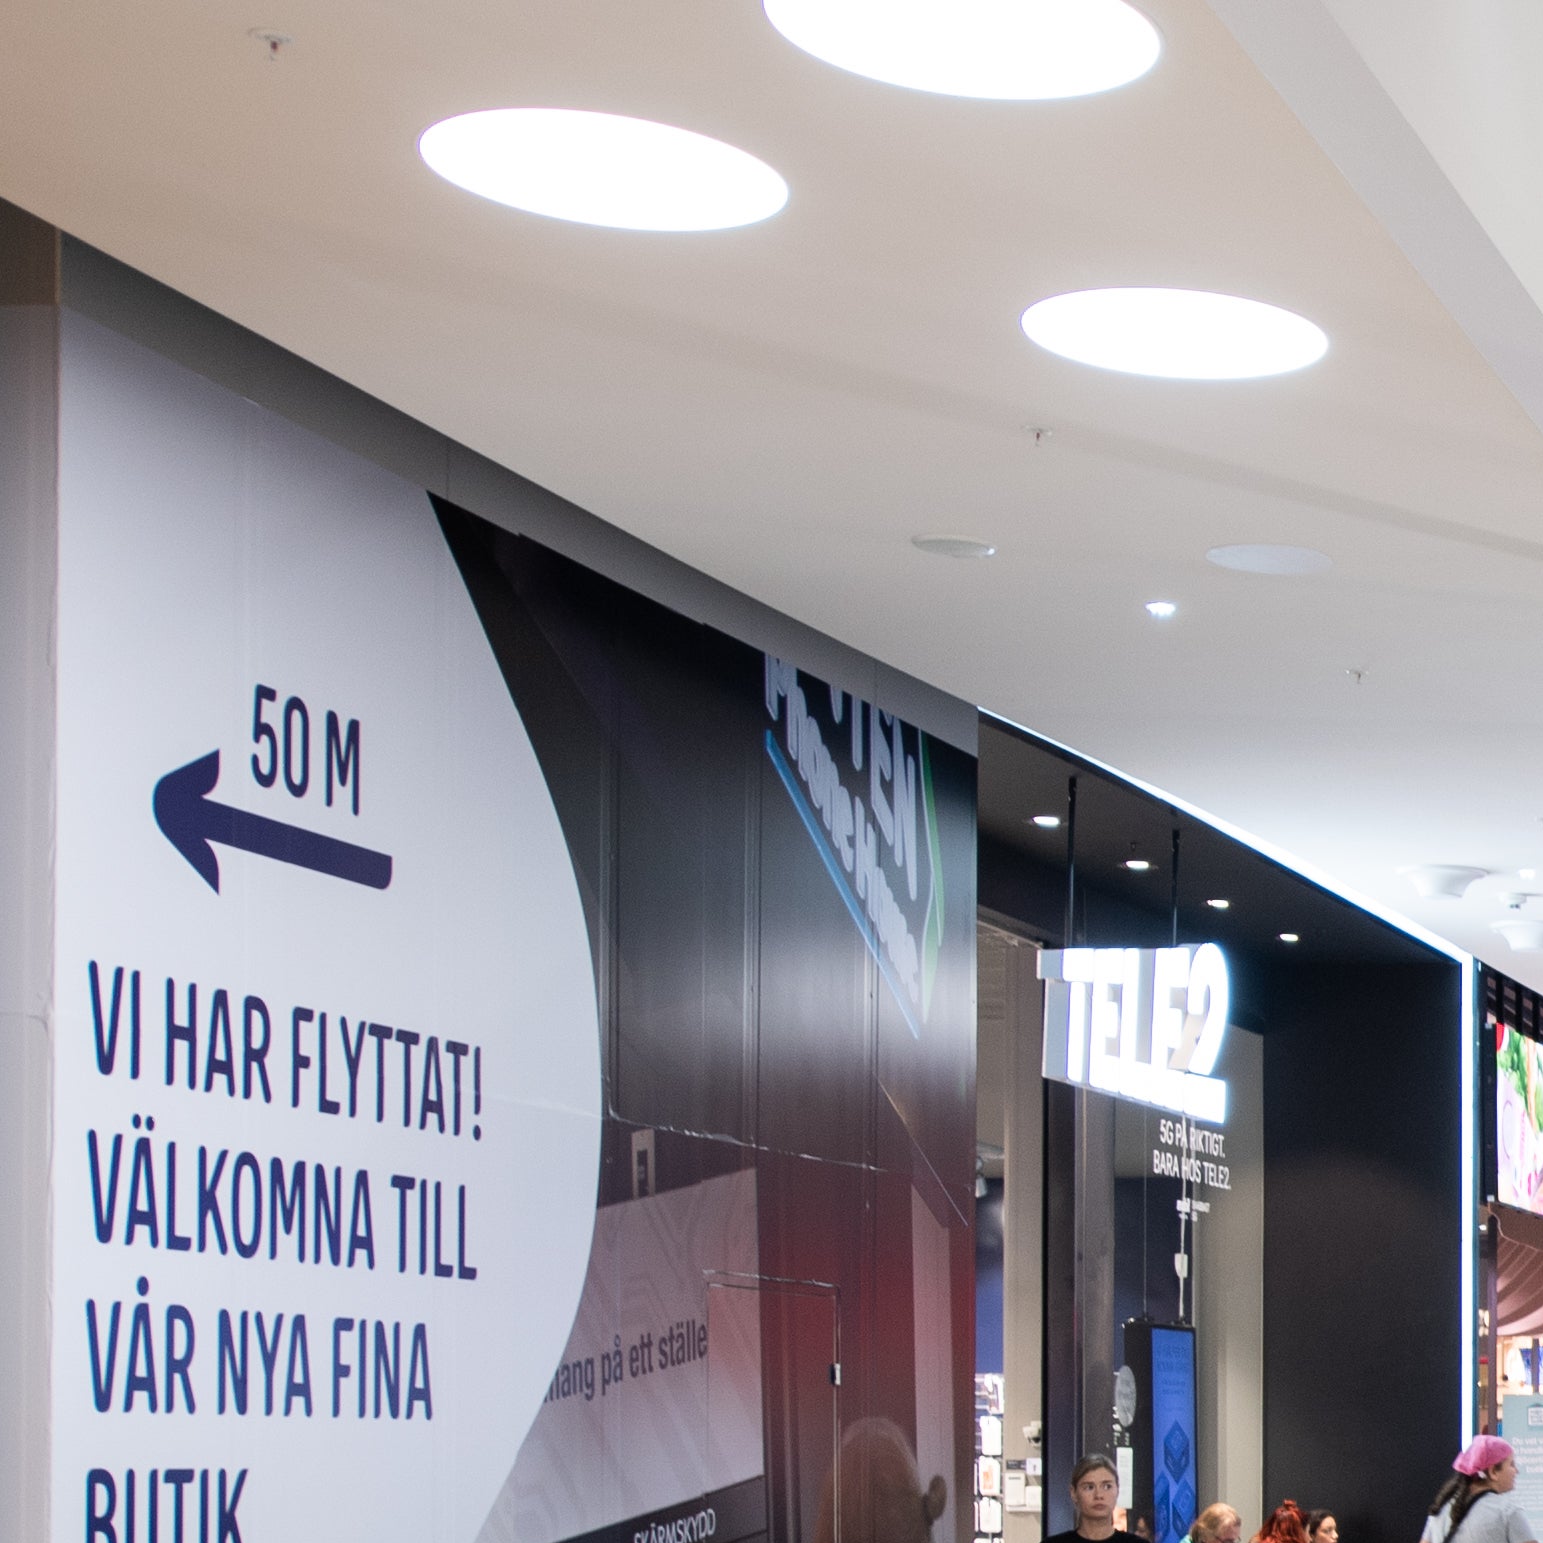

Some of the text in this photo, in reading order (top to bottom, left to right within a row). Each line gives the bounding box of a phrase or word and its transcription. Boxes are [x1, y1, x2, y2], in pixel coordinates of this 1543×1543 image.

[251, 684, 360, 815] 50 M
[88, 960, 482, 1141] VI HAR FLYTTAT!
[1060, 942, 1229, 1124] TELE2
[87, 1114, 477, 1281] VÄLKOMNA TILL
[1152, 1149, 1232, 1190] BARA HOS TELE2.
[1159, 1119, 1173, 1144] 5G
[1190, 1127, 1226, 1158] RIKTIGT.
[86, 1277, 432, 1421] VÅR NYA FINA
[601, 1335, 623, 1396] på
[629, 1332, 653, 1378] ett
[658, 1319, 707, 1370] ställe
